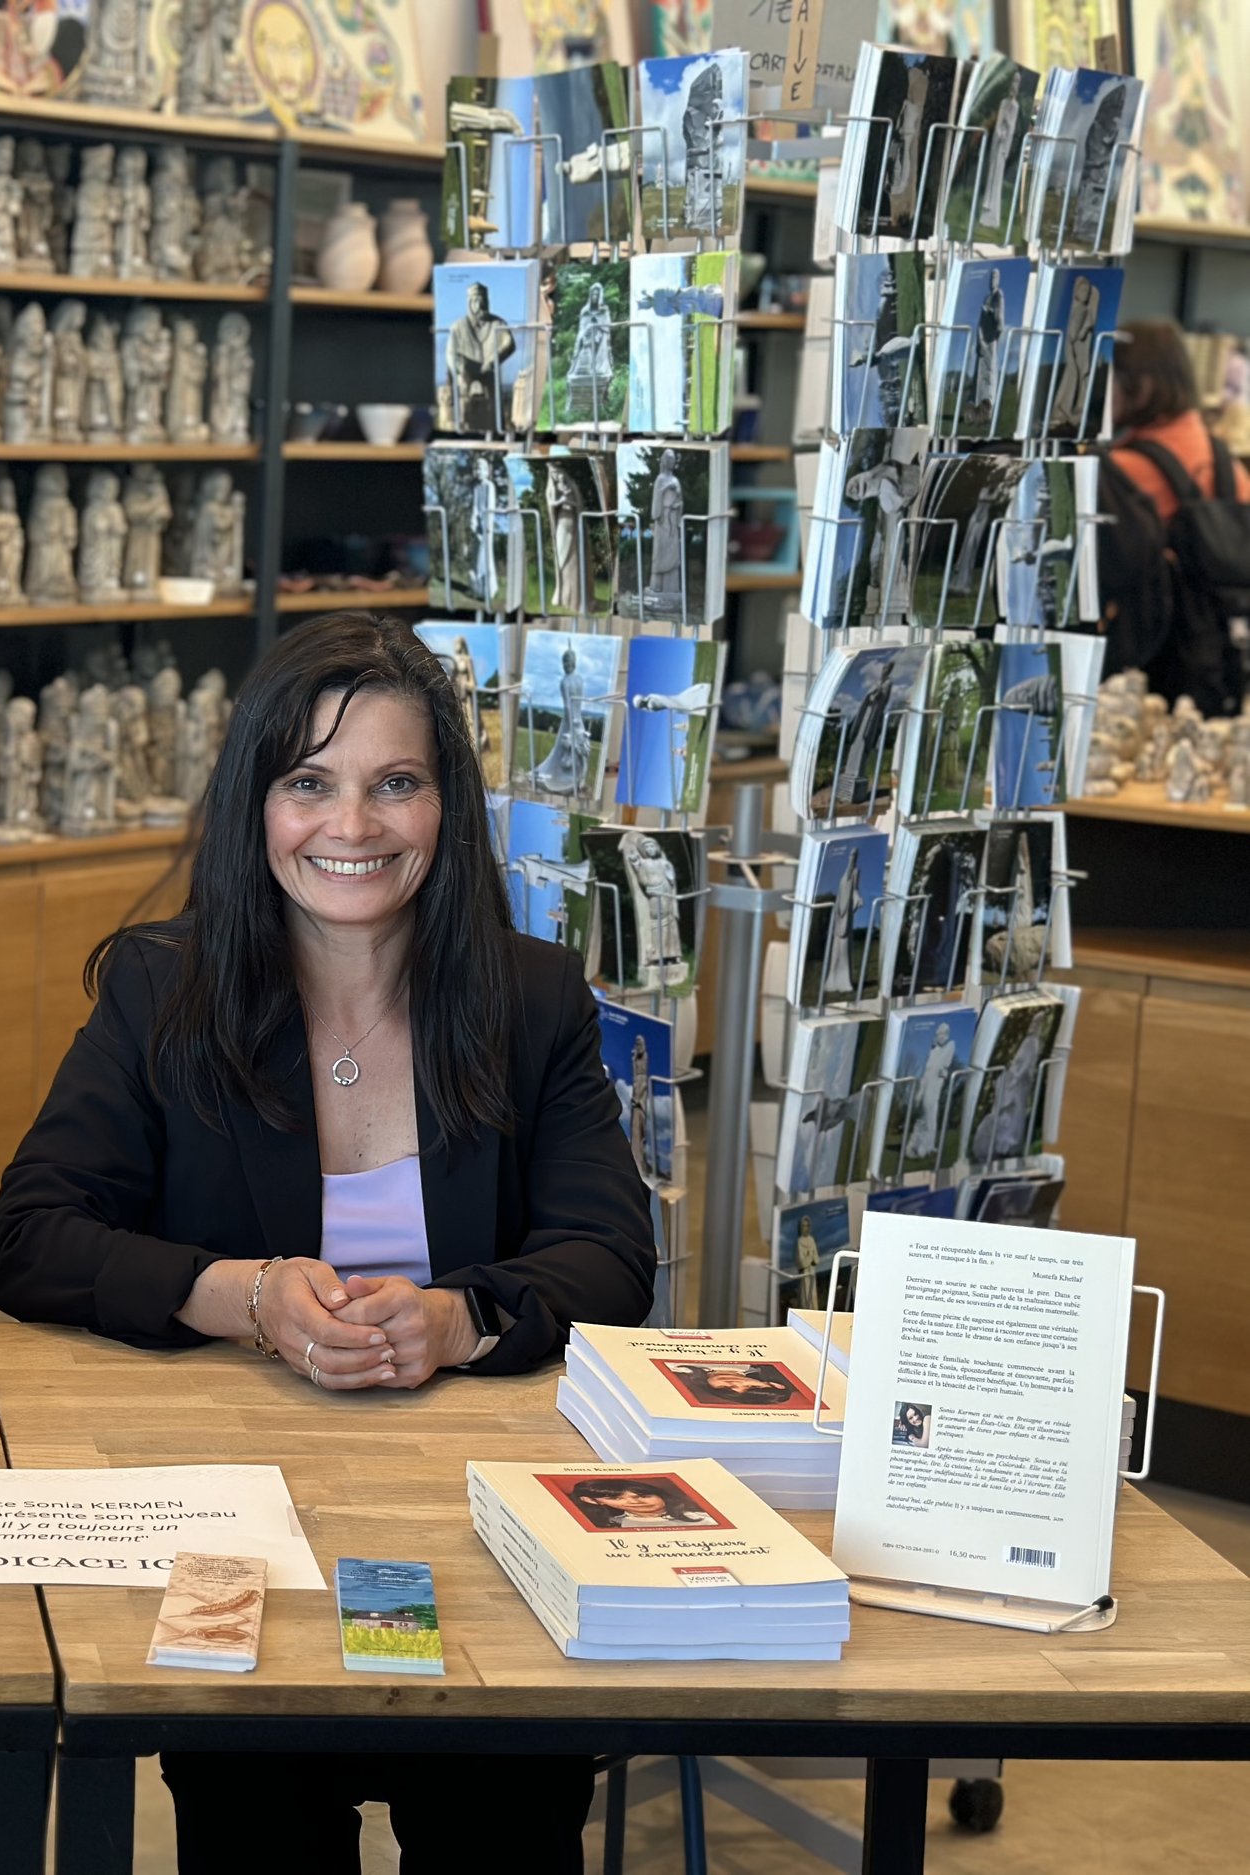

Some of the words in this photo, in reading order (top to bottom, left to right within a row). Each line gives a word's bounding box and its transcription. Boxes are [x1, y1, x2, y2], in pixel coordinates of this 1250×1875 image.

[749, 52, 786, 72] CART
[791, 82, 802, 101] E
[941, 1247, 976, 1255] récupérable
[1038, 1256, 1058, 1264] temps,
[941, 1255, 965, 1263] manque
[906, 1275, 931, 1284] Derrière
[1033, 1272, 1058, 1280] Mostefa
[1059, 1275, 1083, 1283] Khellaf
[905, 1285, 940, 1294] témoignage
[942, 1289, 970, 1297] poignant,
[1024, 1298, 1062, 1306] maltraitance
[925, 1295, 945, 1303] enfant,
[1020, 1305, 1044, 1313] relation
[921, 1310, 941, 1319] femme
[943, 1313, 961, 1321] pleine
[1005, 1321, 1037, 1329] également
[900, 1350, 912, 1358] Une
[916, 1352, 939, 1360] histoire
[943, 1355, 970, 1364] familiale
[974, 1360, 1003, 1368] touchante
[1007, 1364, 1044, 1372] commencée
[24, 1501, 83, 1509] Sonia
[92, 1501, 183, 1509] KERMEN
[142, 1511, 237, 1520] nouveau
[17, 1522, 31, 1530] y
[58, 1522, 145, 1532] toujours
[606, 1538, 628, 1550] Il
[667, 1540, 747, 1551] toujours
[638, 1546, 770, 1558] commencement
[949, 1550, 968, 1559] 16,50
